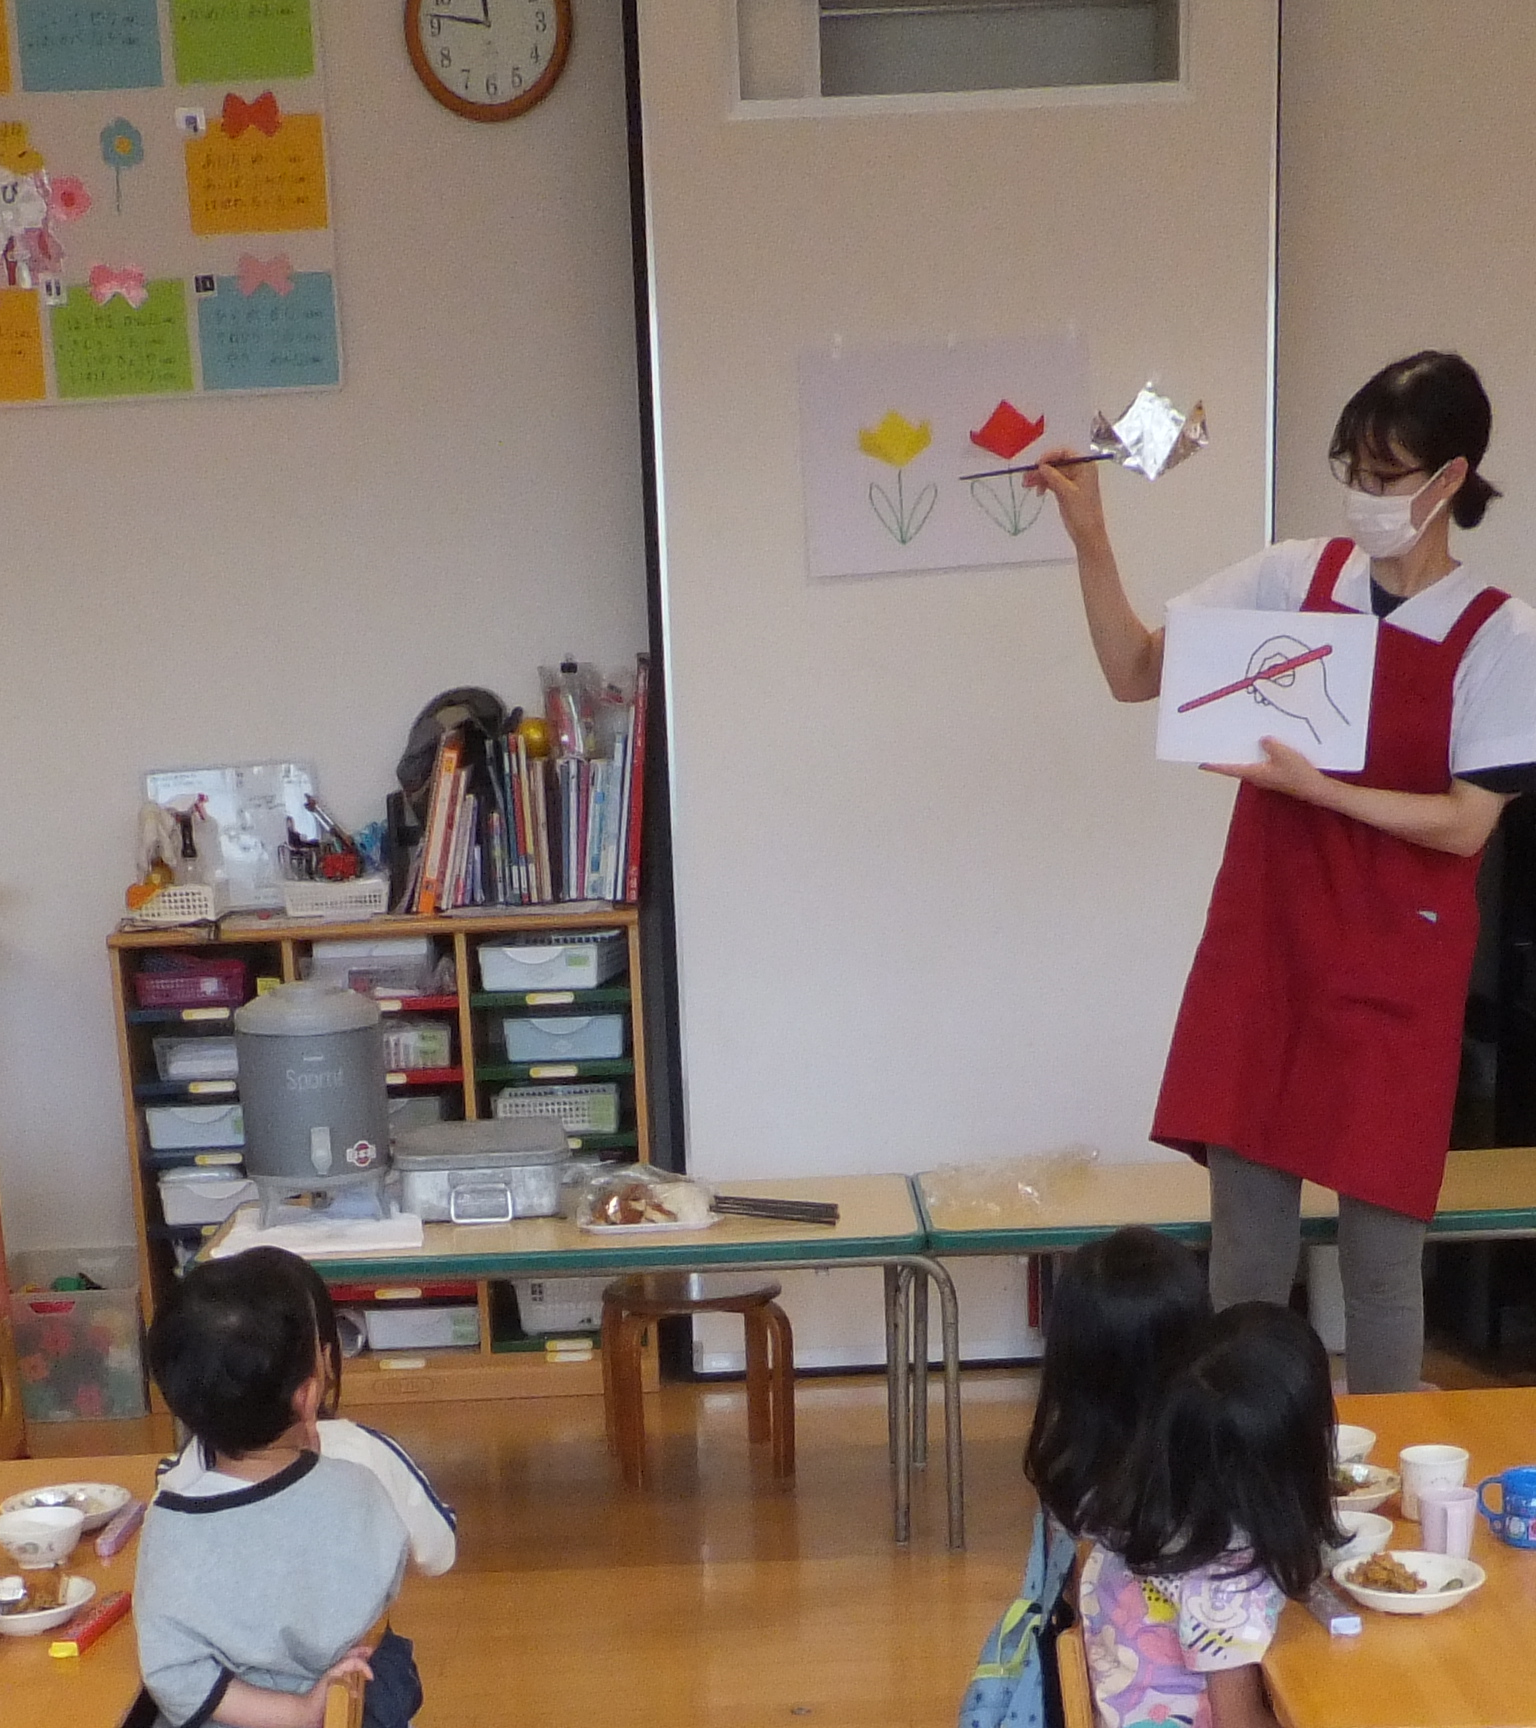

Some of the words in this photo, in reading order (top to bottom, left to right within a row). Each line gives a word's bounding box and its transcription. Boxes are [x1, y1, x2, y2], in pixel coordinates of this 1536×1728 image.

[535, 11, 547, 32] 3
[440, 47, 452, 69] 8
[530, 44, 540, 64] 4
[461, 68, 471, 90] 7
[485, 75, 498, 96] 6
[511, 67, 523, 88] 5
